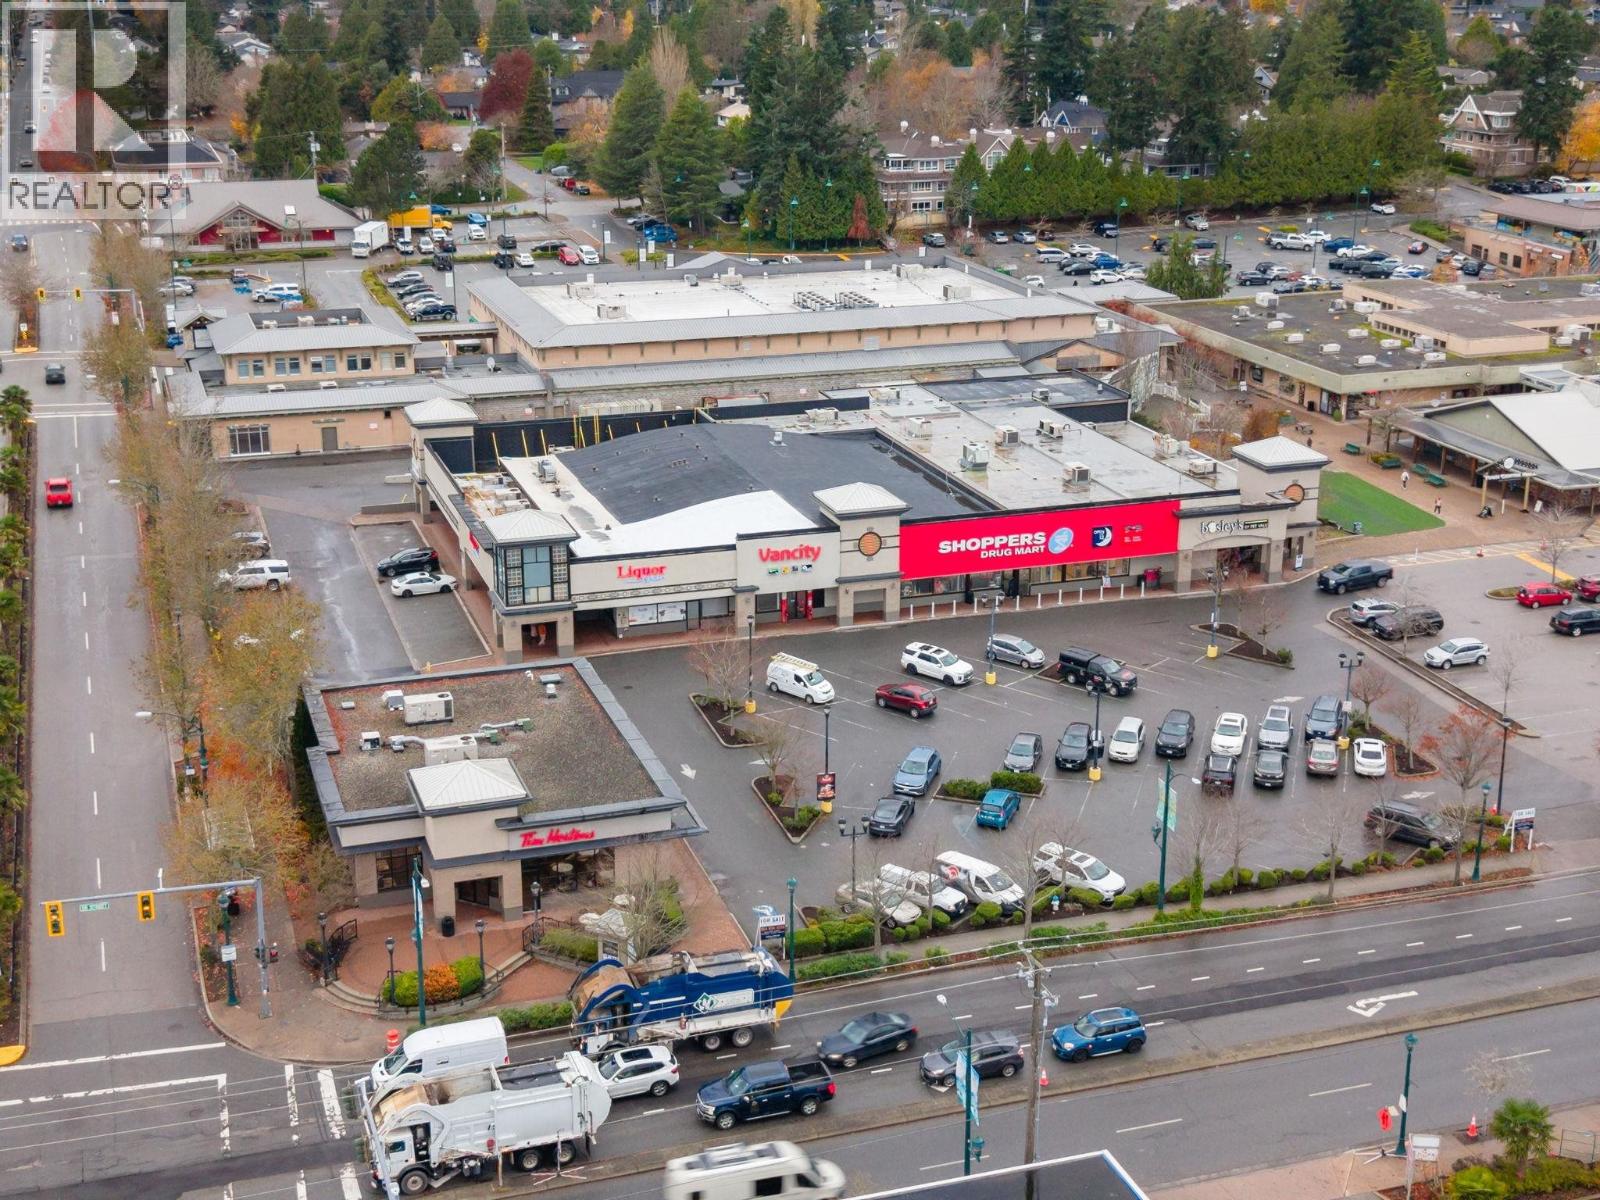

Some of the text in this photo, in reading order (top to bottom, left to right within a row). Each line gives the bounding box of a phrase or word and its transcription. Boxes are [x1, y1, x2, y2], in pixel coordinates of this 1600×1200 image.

[938, 531, 1047, 554] SHOPPERS
[758, 544, 822, 562] Vancity
[980, 545, 1046, 559] DRUG MART
[616, 564, 667, 580] Liquor
[520, 823, 597, 848] Tim Hortons
